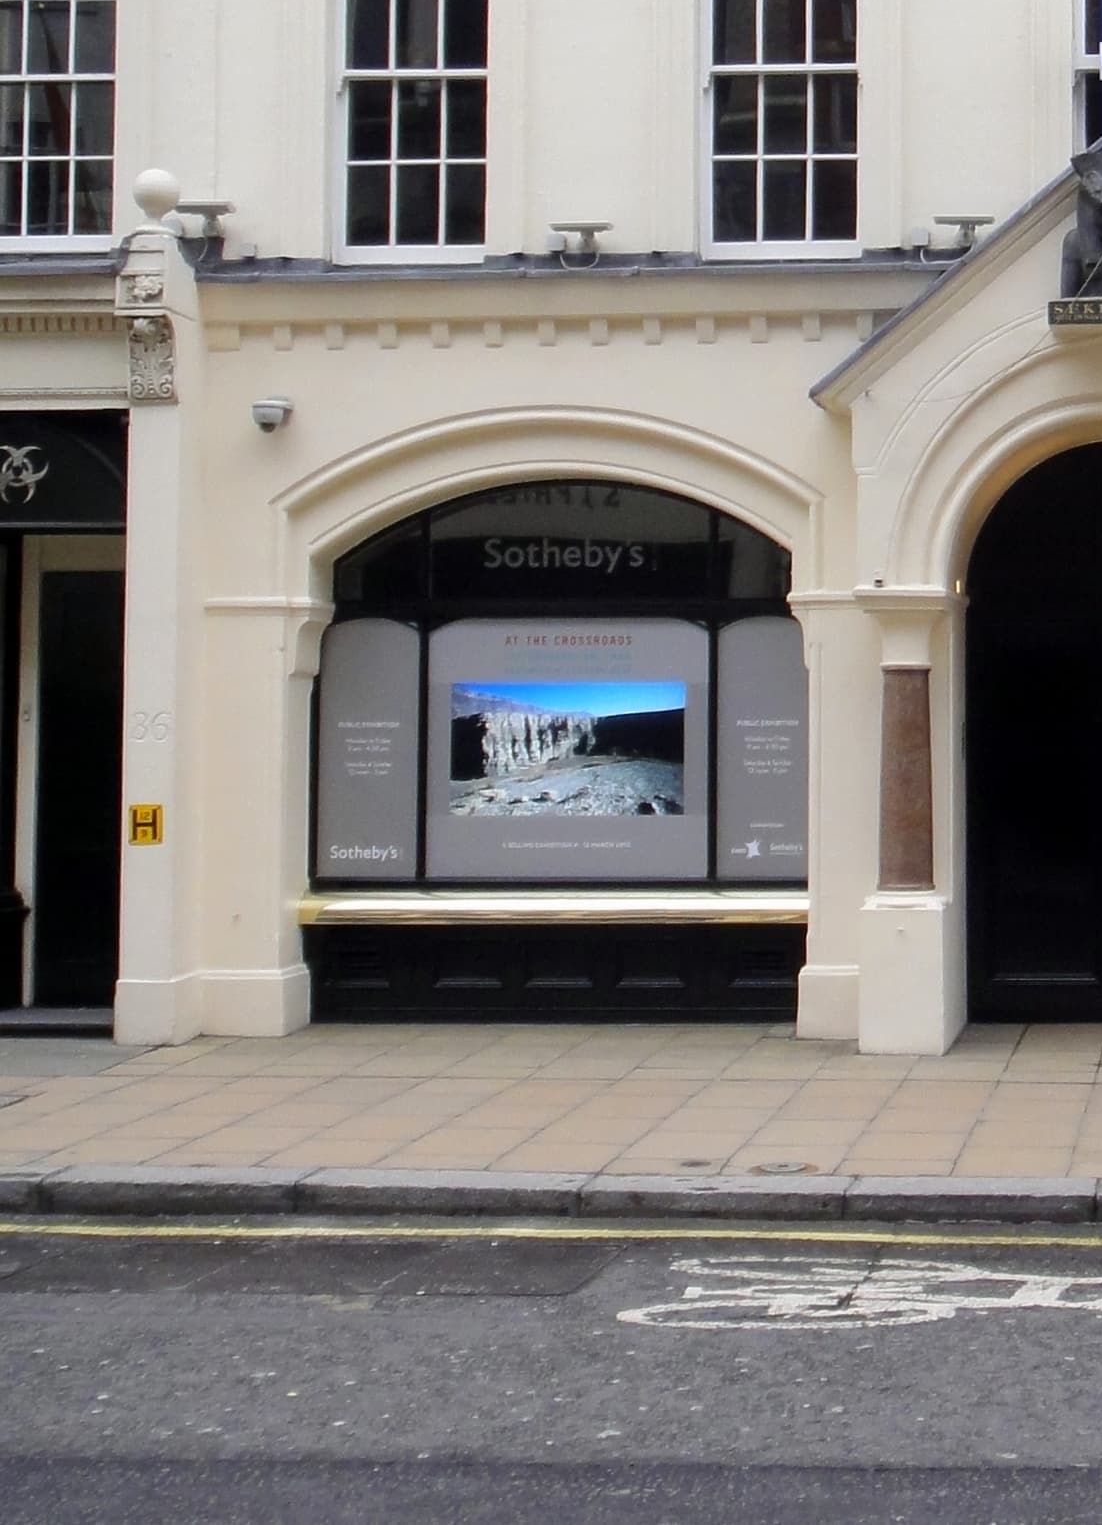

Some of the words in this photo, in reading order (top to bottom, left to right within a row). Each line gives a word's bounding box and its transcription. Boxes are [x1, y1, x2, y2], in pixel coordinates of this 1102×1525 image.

[484, 537, 645, 573] Sotheby's
[527, 635, 547, 646] THE
[553, 635, 632, 646] CROSSROADS
[132, 809, 158, 841] H
[329, 845, 398, 862] Sotheby's
